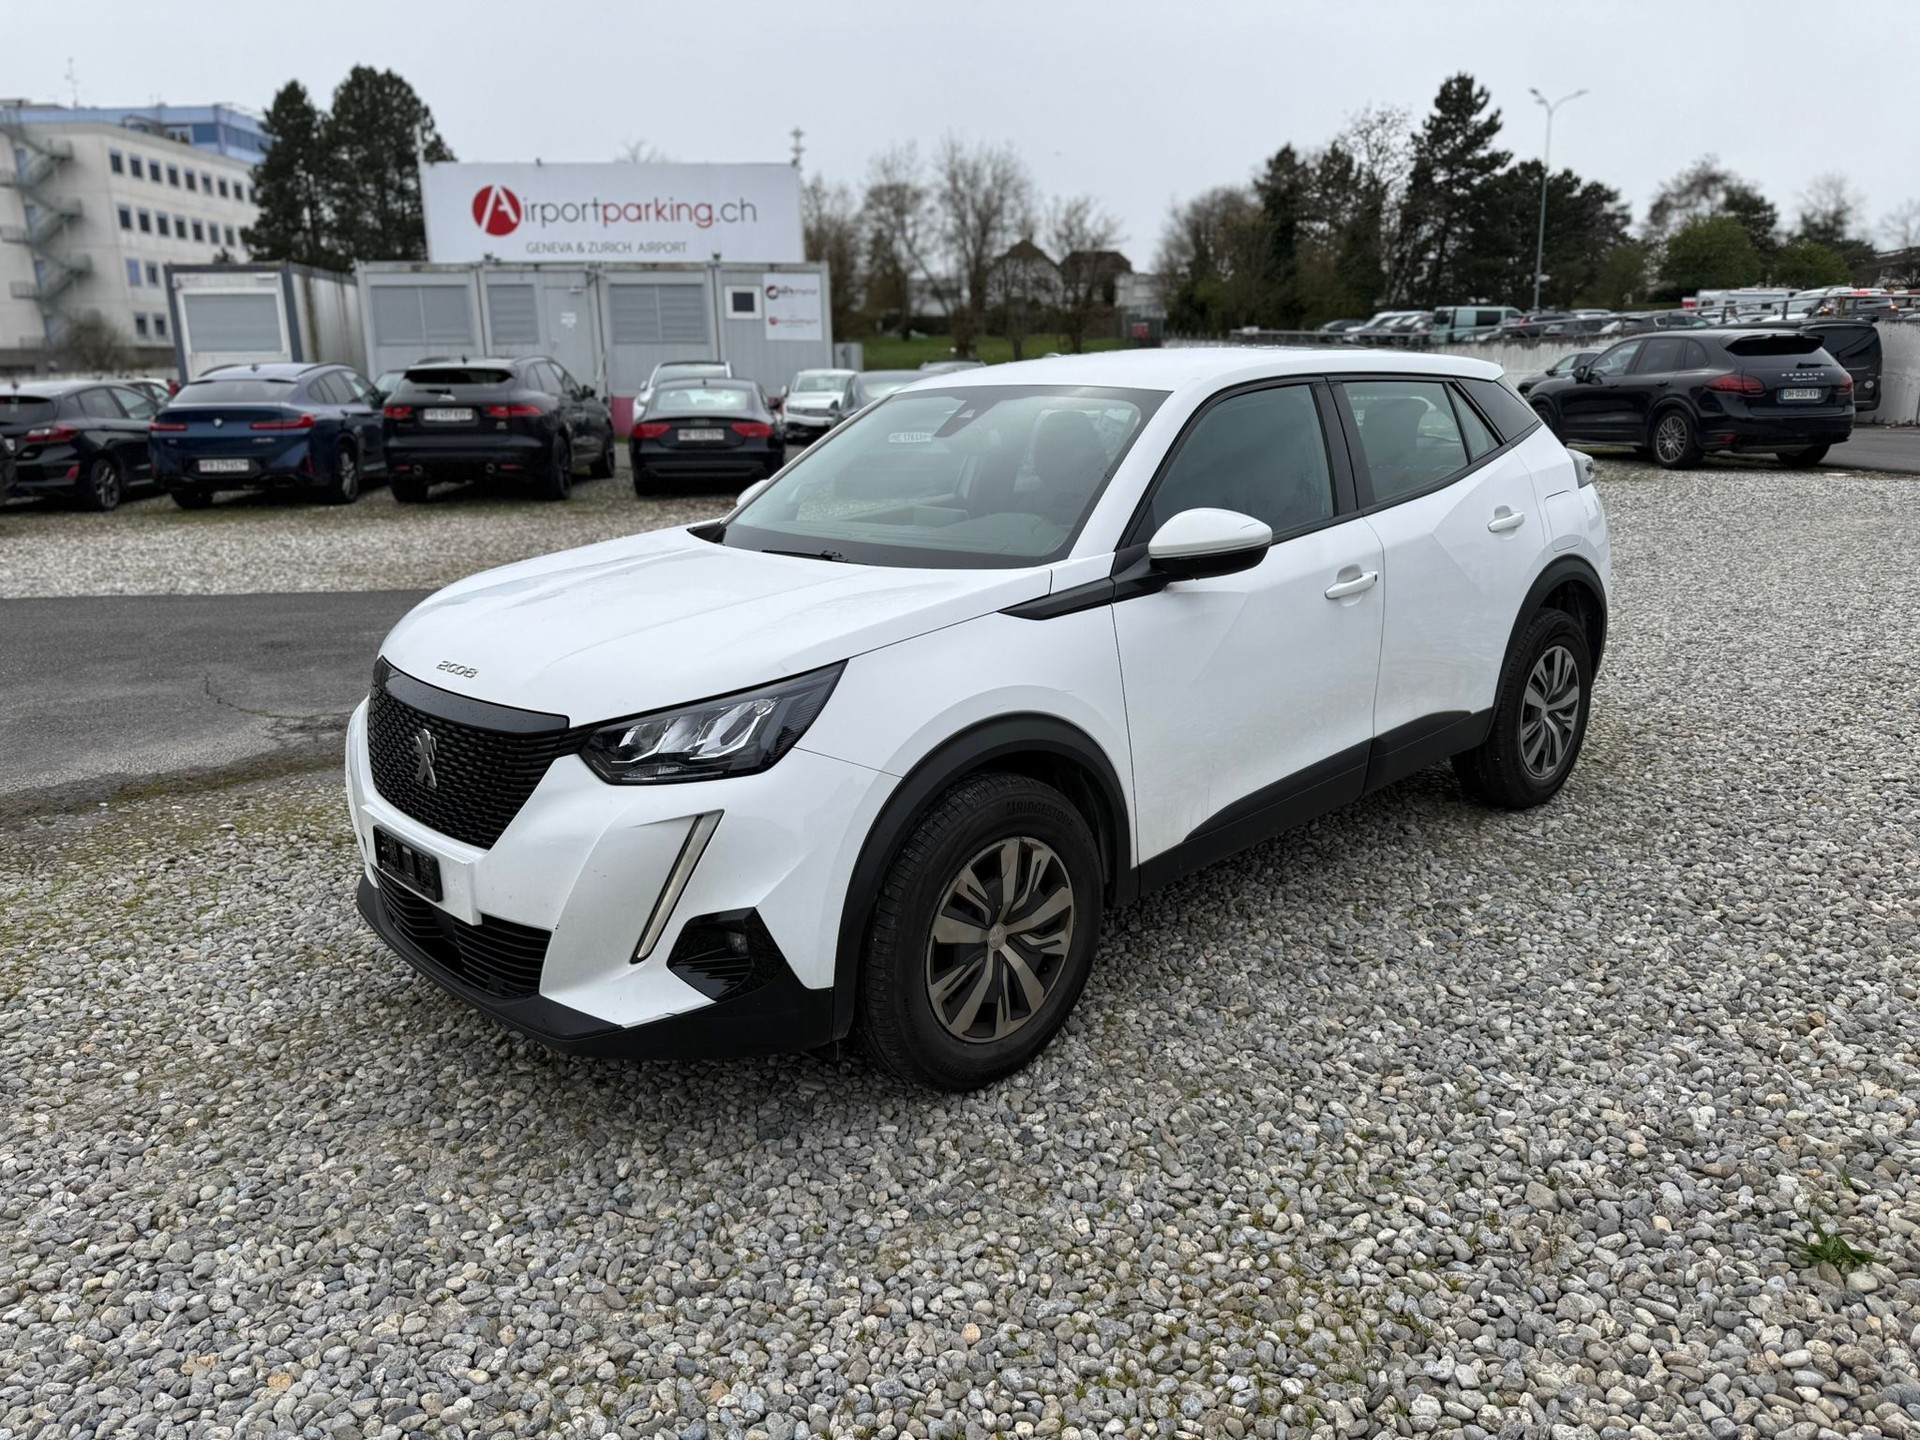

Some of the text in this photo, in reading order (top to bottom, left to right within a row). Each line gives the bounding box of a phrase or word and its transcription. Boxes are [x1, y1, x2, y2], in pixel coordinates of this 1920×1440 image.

[526, 241, 687, 254] GENEVA & ZURICH AIRPORT
[436, 660, 479, 679] 2008
